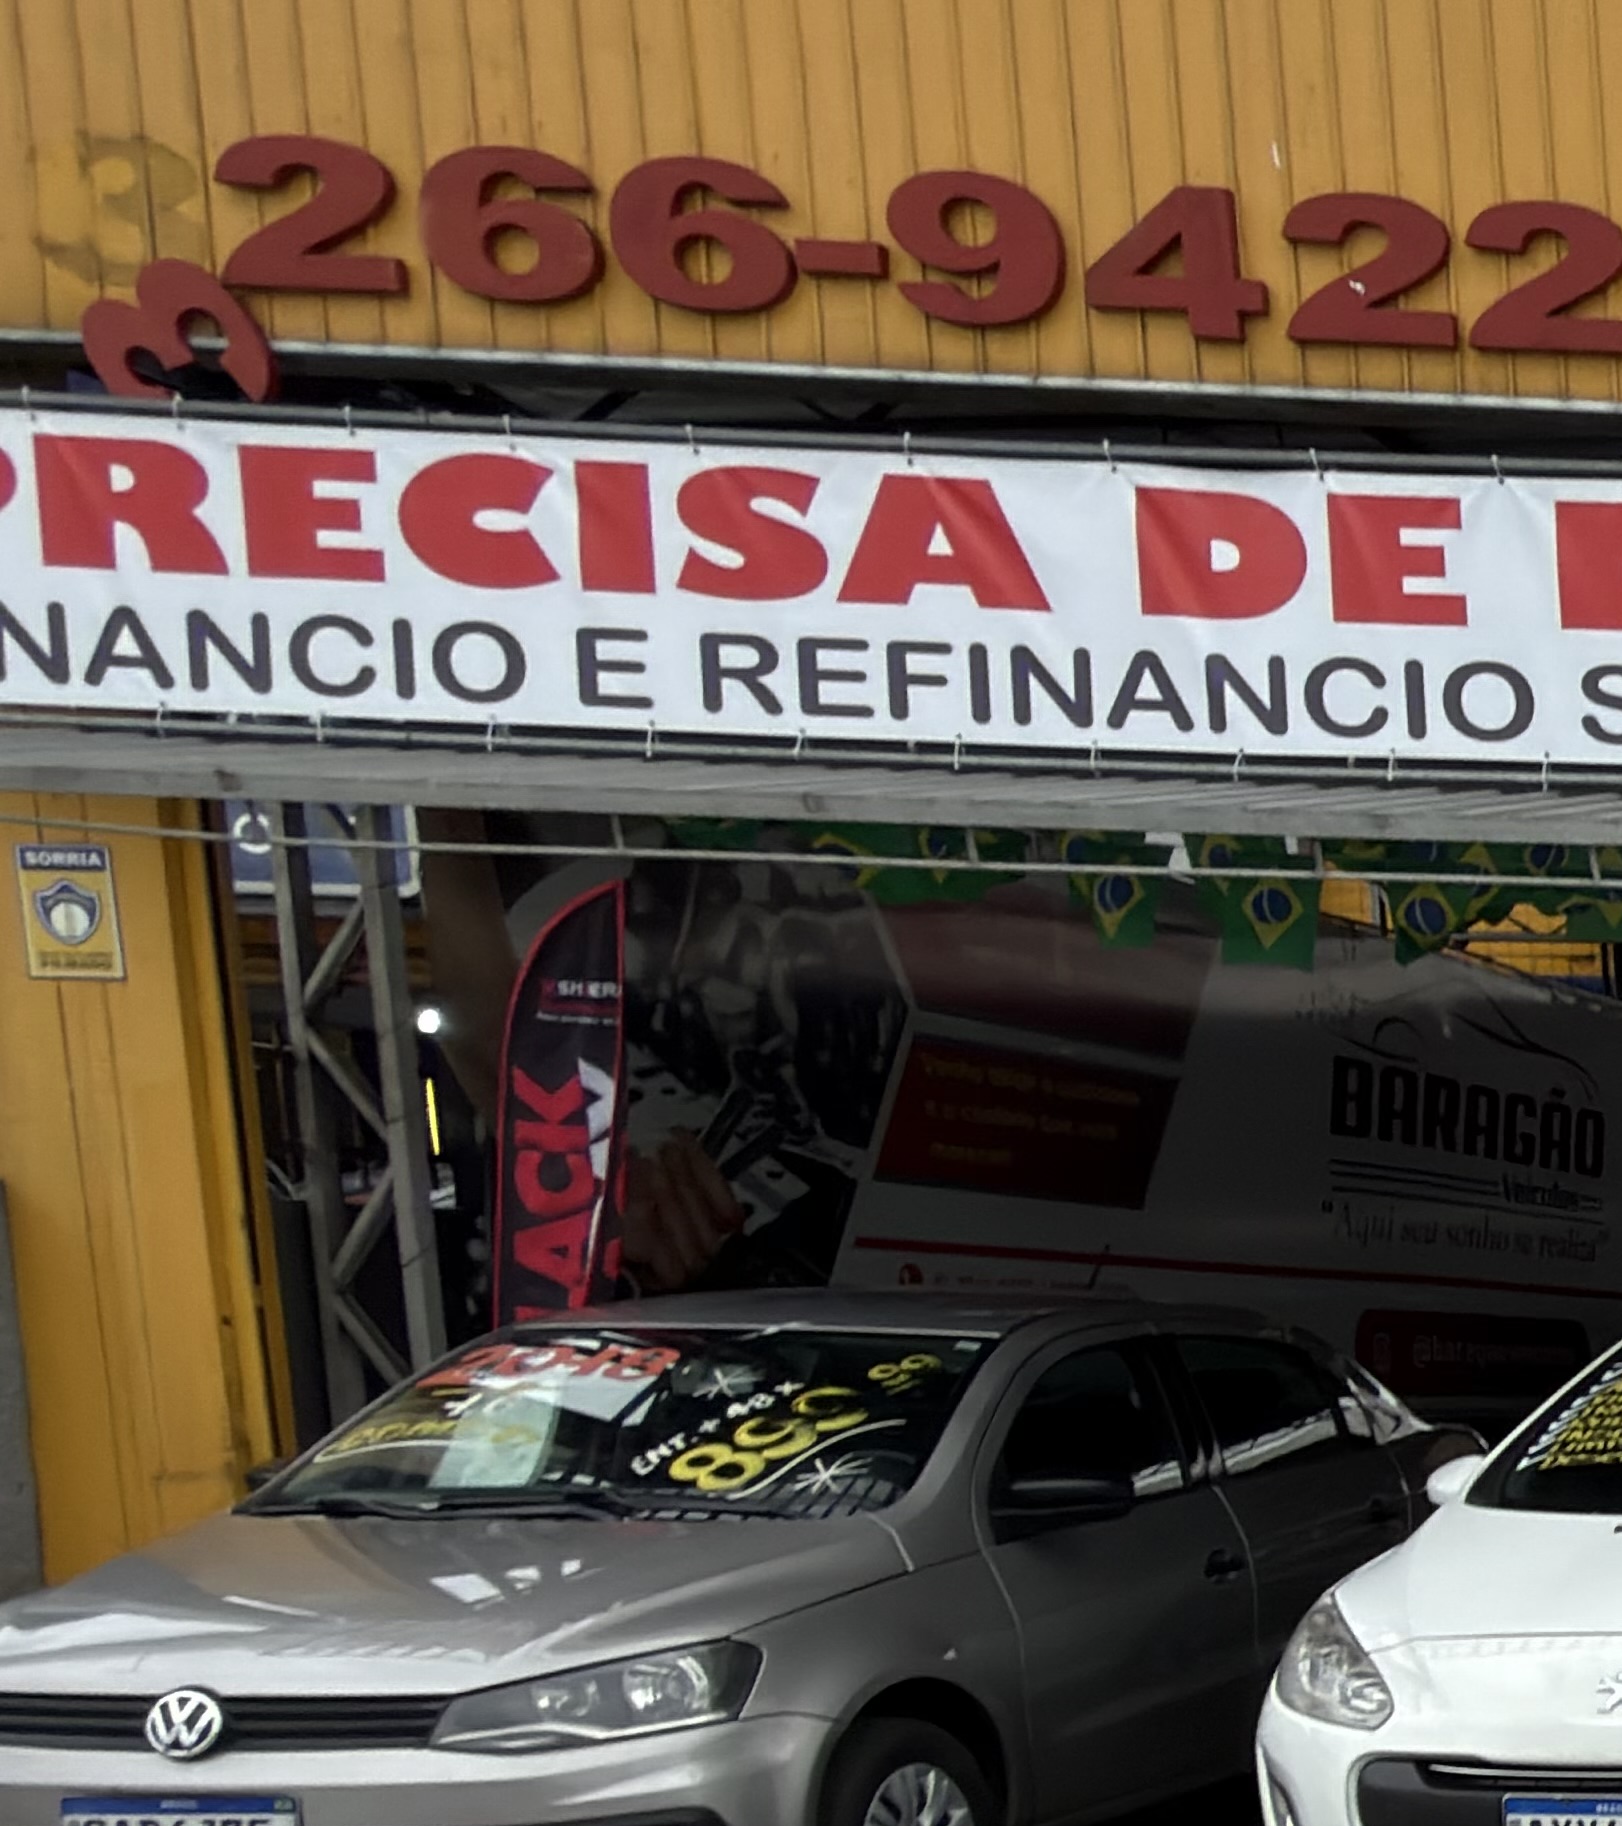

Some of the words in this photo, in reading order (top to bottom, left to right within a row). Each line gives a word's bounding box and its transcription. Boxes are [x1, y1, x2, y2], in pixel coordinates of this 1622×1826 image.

[0, 433, 1050, 612] RECISA
[1136, 486, 1468, 627] DE
[576, 627, 655, 710] E
[701, 631, 1536, 746] REFINANCIO
[23, 851, 102, 866] SORRIA
[1330, 1055, 1606, 1179] BARAGÃO
